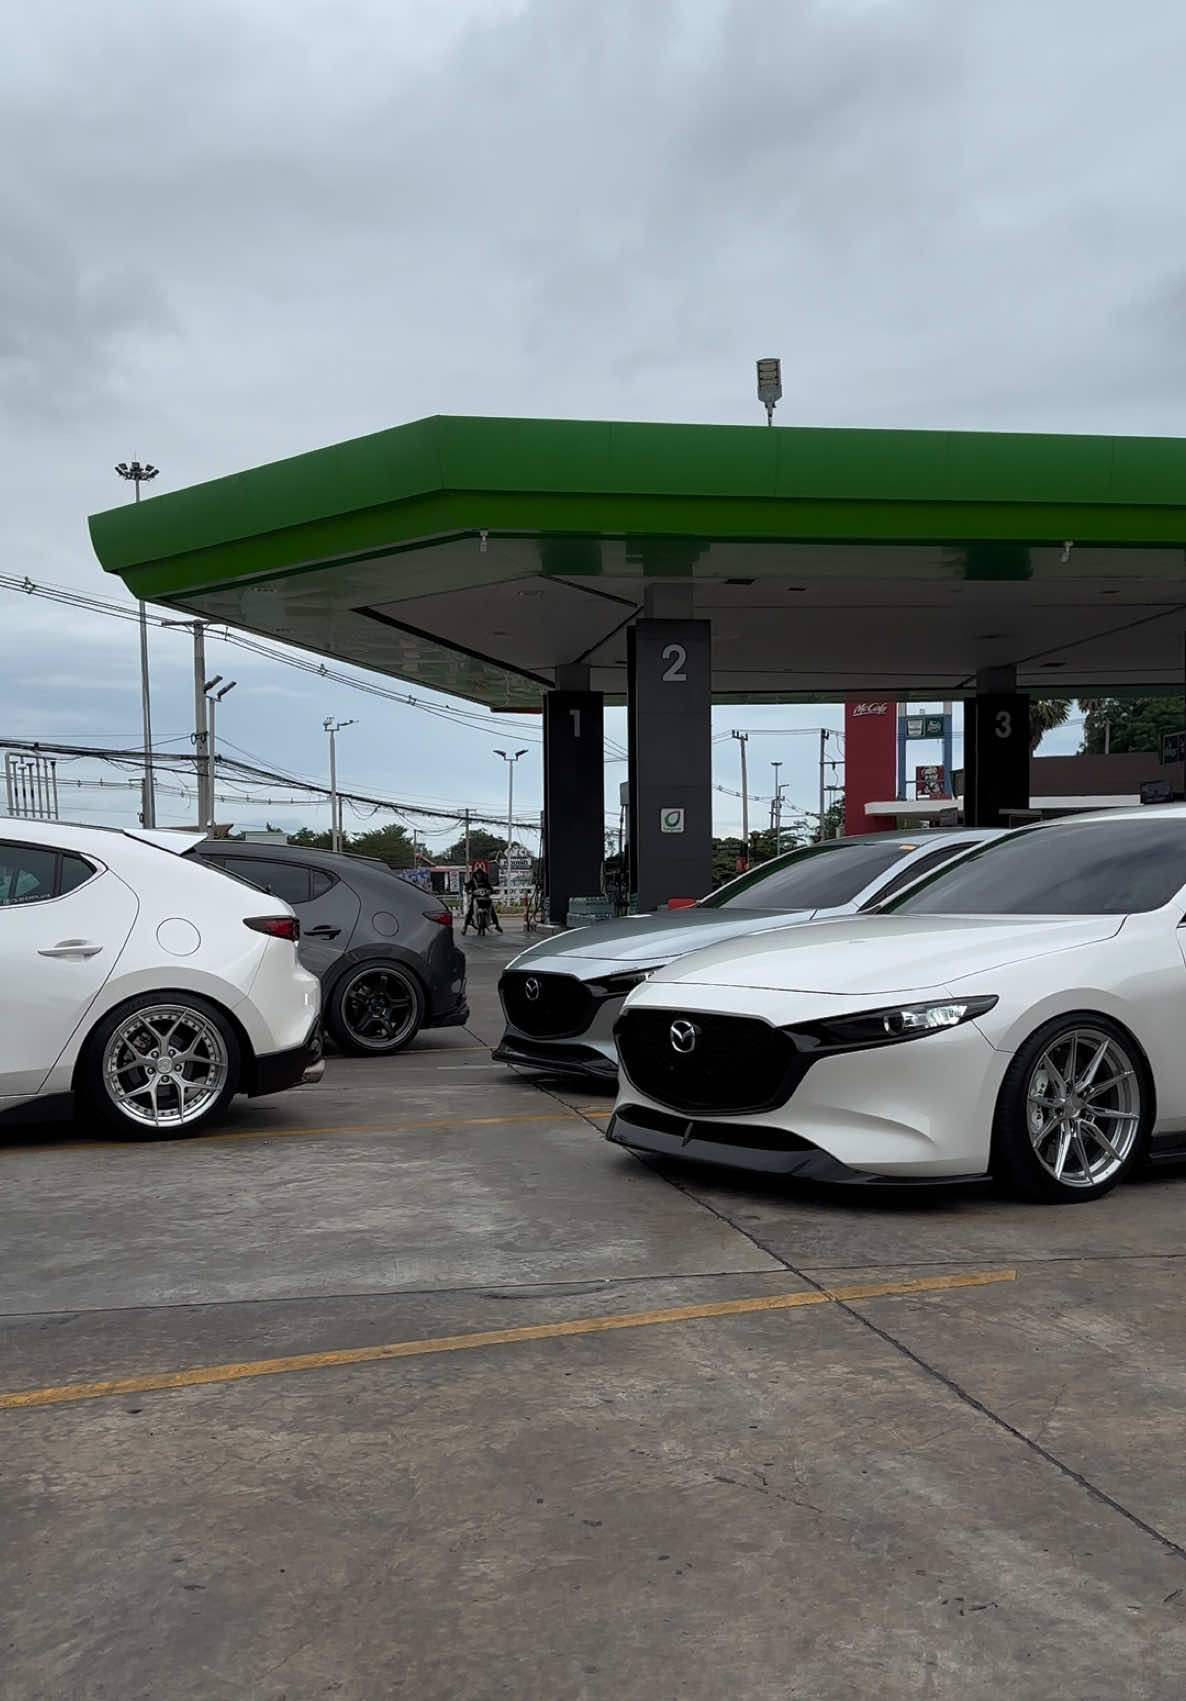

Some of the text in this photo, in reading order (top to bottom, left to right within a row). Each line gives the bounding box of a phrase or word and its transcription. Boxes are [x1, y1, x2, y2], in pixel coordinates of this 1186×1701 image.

[662, 644, 687, 682] 2
[569, 709, 581, 737] 1
[995, 711, 1011, 738] 3
